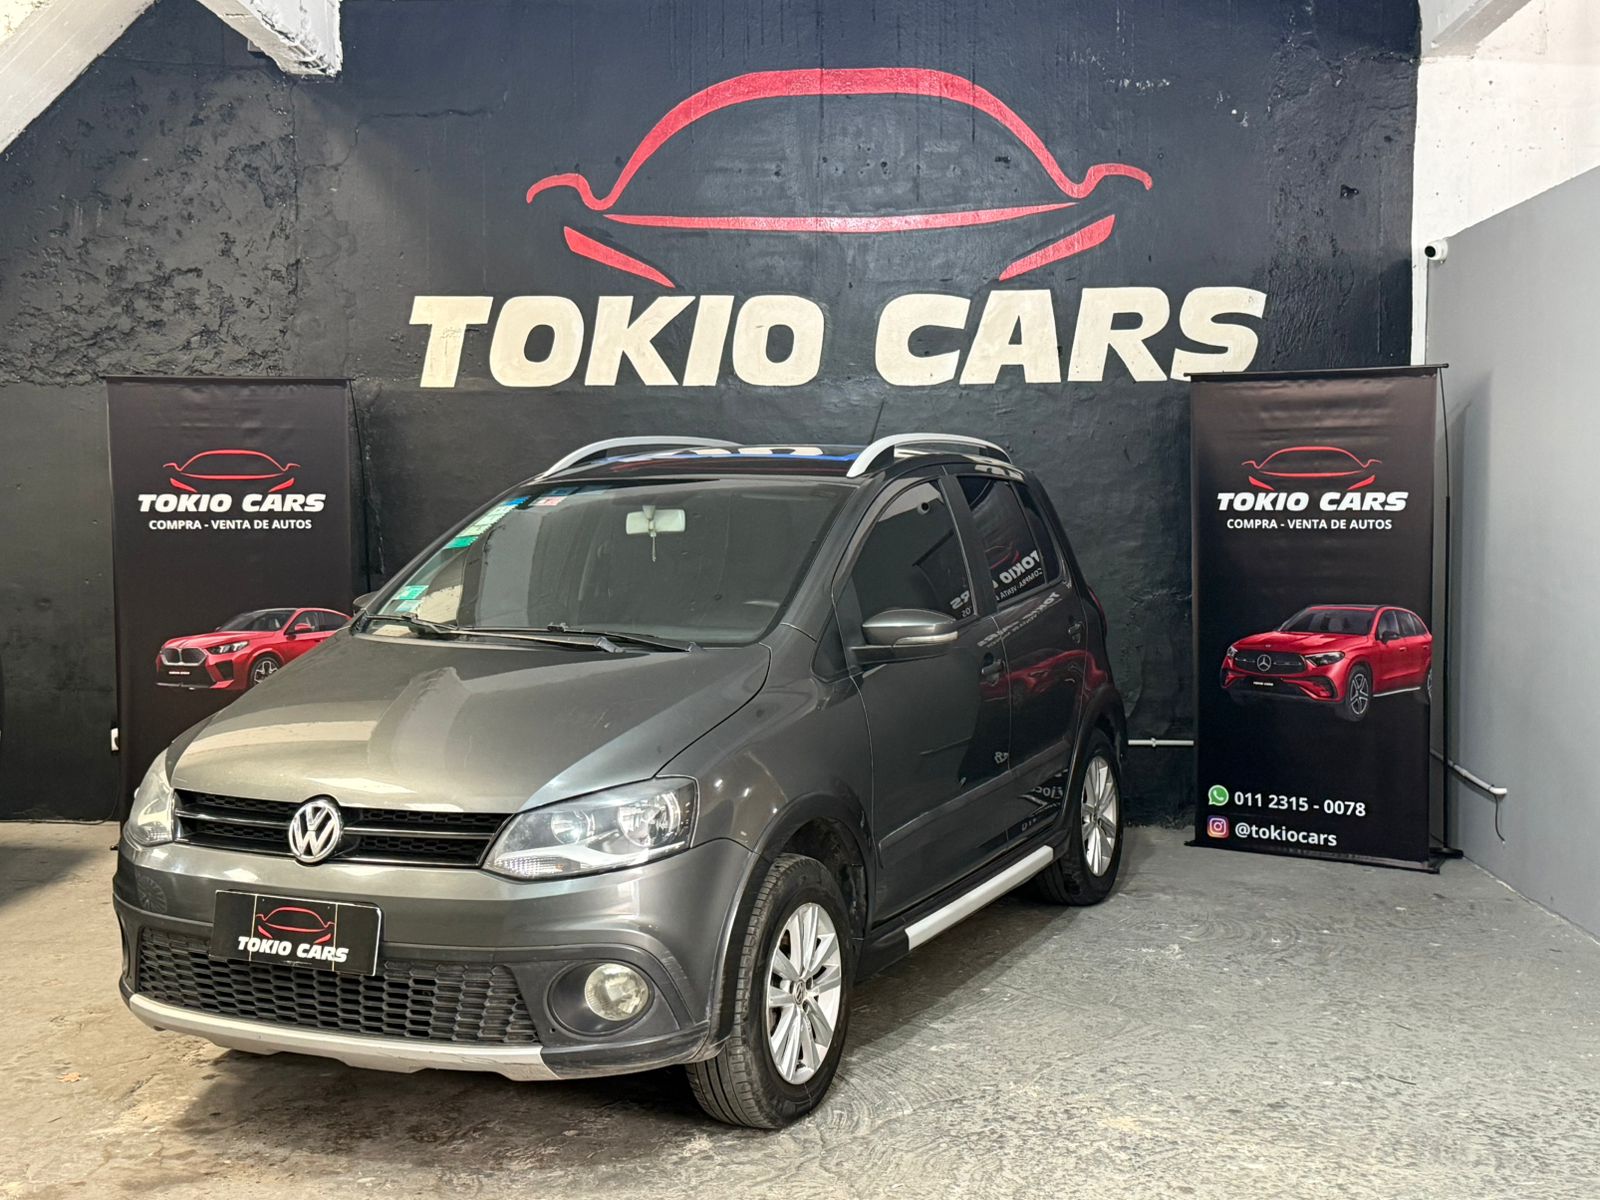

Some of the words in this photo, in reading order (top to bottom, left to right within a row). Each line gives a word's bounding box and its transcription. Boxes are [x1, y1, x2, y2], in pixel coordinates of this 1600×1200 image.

[408, 295, 825, 389] TOKIO
[875, 286, 1268, 386] CARS
[138, 493, 232, 513] TOKIO
[242, 493, 326, 513] CARS
[1217, 492, 1309, 512] TOKIO
[1319, 492, 1408, 512] CARS
[149, 519, 202, 530] COMPRA
[211, 519, 251, 530] VENTA
[254, 519, 270, 530] DE
[272, 519, 312, 530] AUTOS
[1227, 518, 1278, 529] COMPRA
[1287, 518, 1328, 529] VENTA
[1330, 519, 1347, 530] DE
[1349, 519, 1393, 530] AUTOS
[1234, 791, 1262, 807] 011
[1268, 794, 1309, 812] 2315
[1323, 799, 1366, 817] 0078
[1235, 822, 1337, 846] @tokiocars
[238, 936, 292, 956] TOKIO
[296, 943, 349, 963] CARS
